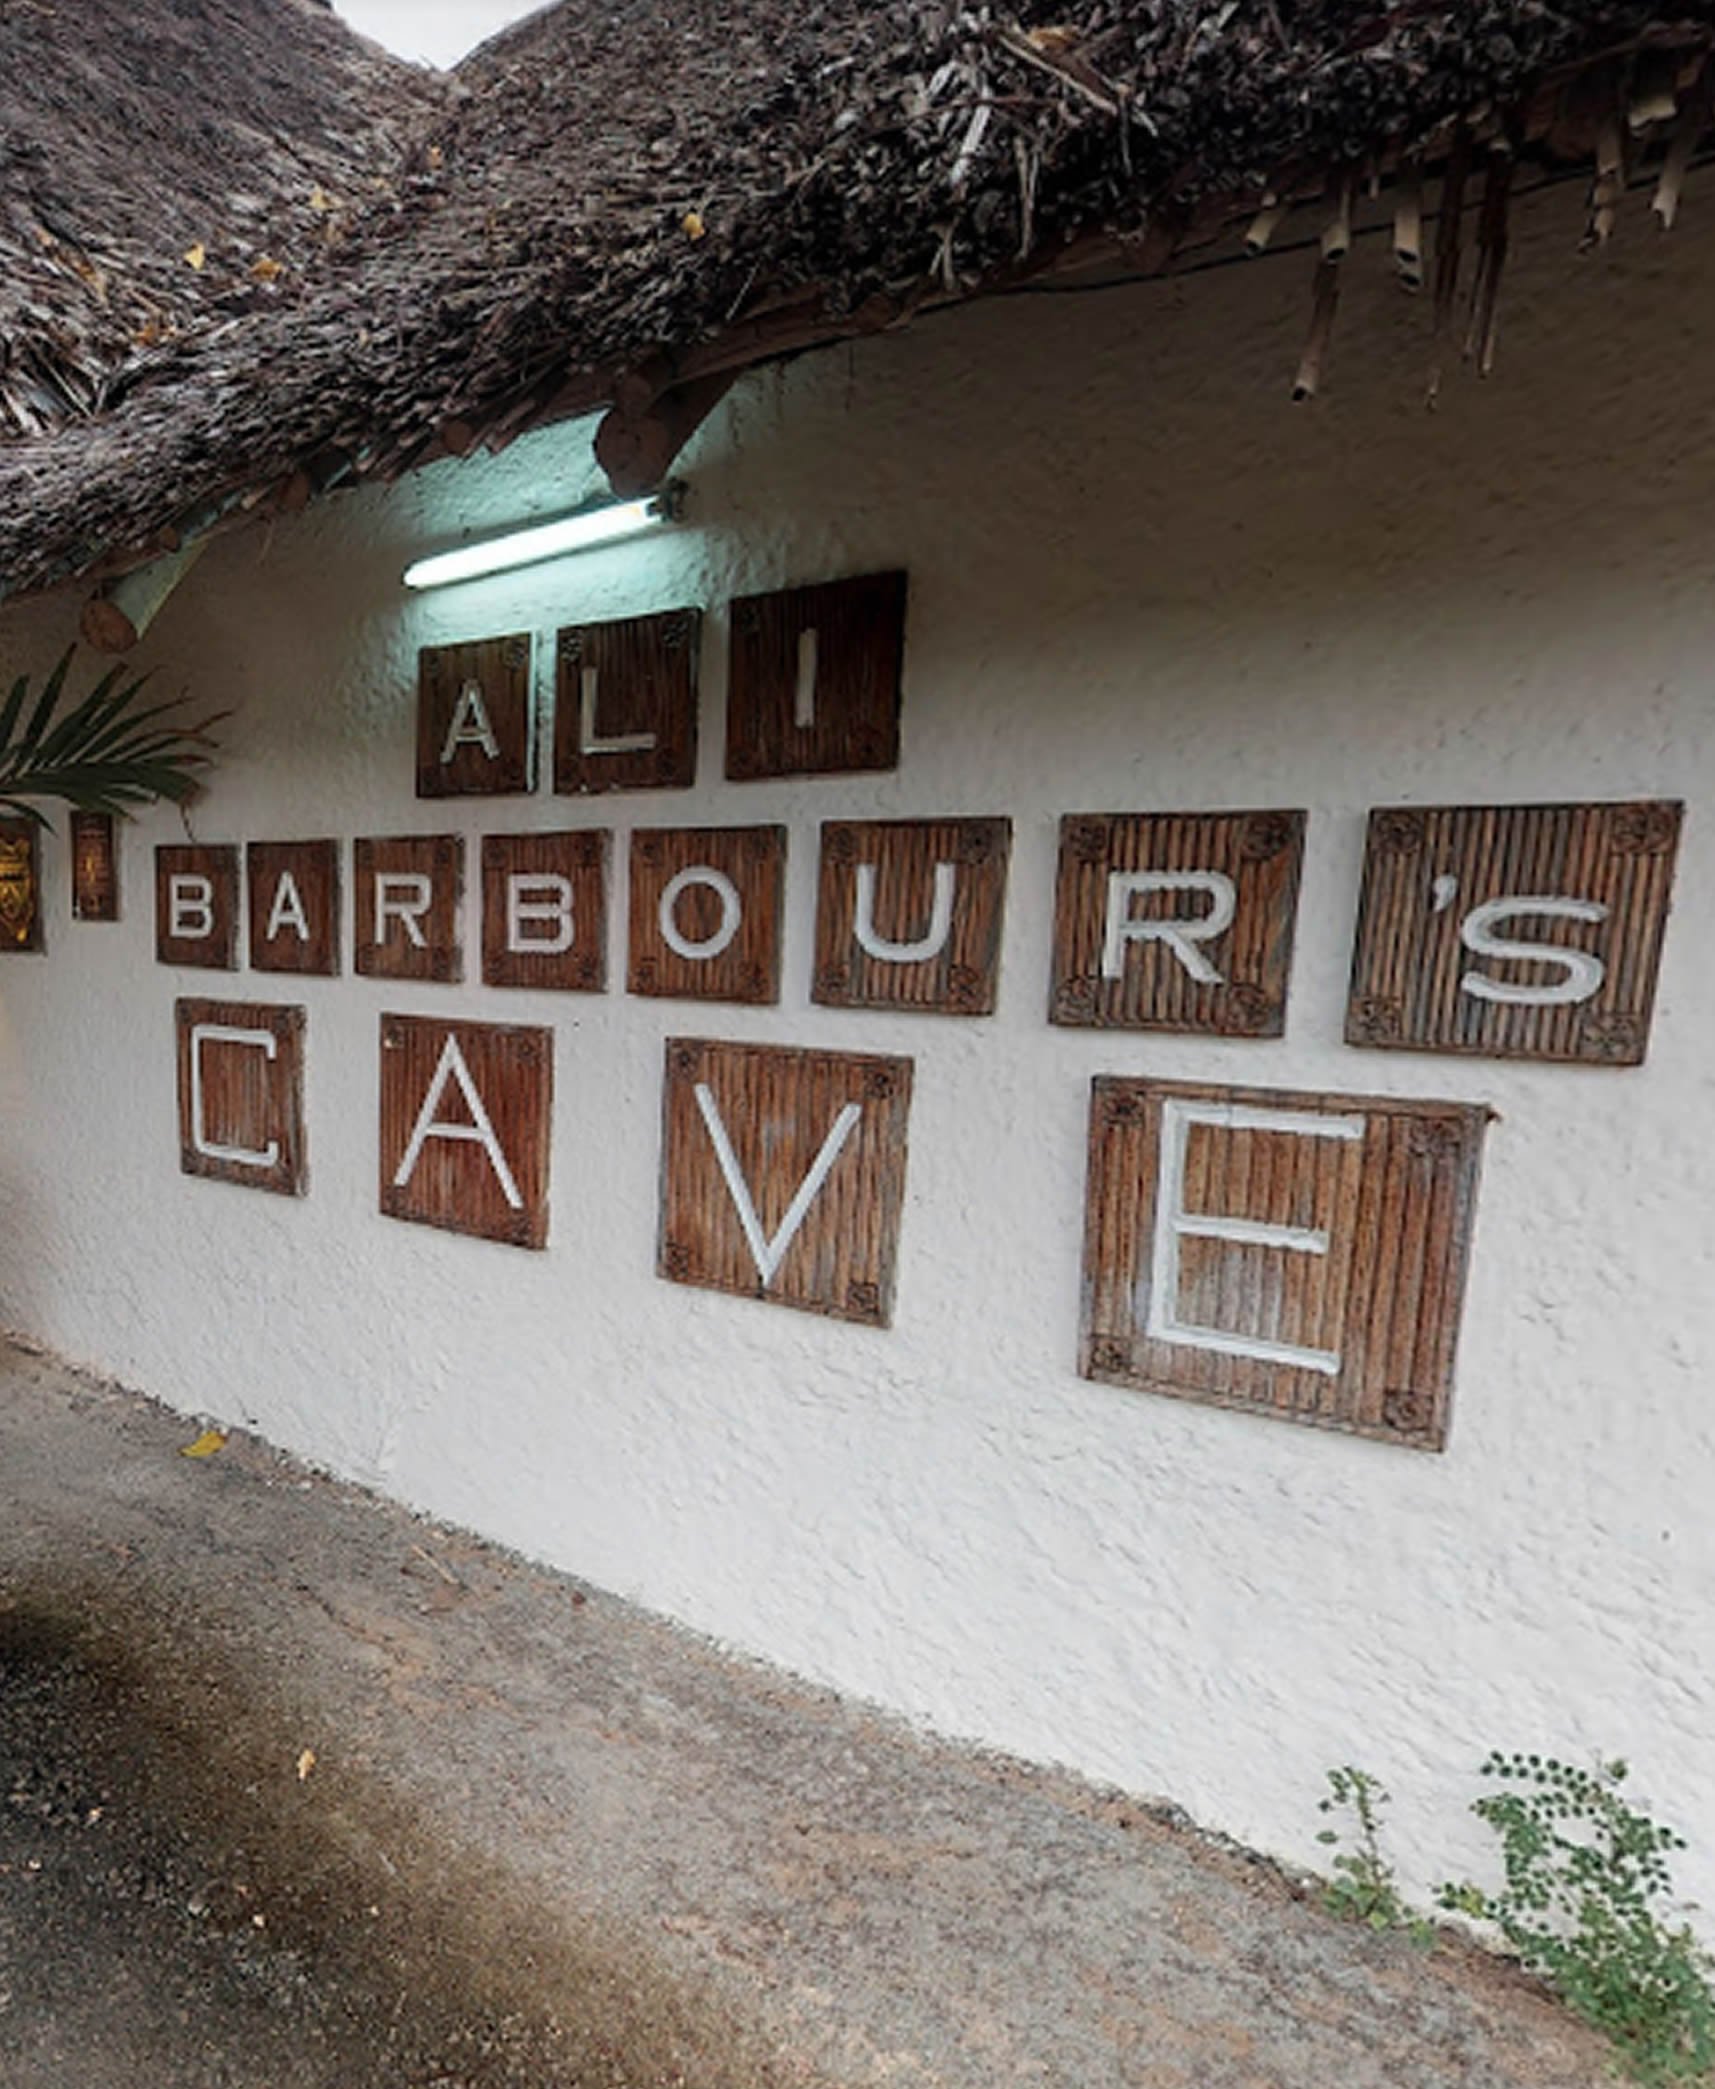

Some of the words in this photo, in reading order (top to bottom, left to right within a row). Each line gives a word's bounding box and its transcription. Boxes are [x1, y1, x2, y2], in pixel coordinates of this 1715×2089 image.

[440, 627, 818, 764] ALI
[168, 864, 1608, 1005] BARBOUR'S
[191, 1024, 1365, 1375] CAVE
